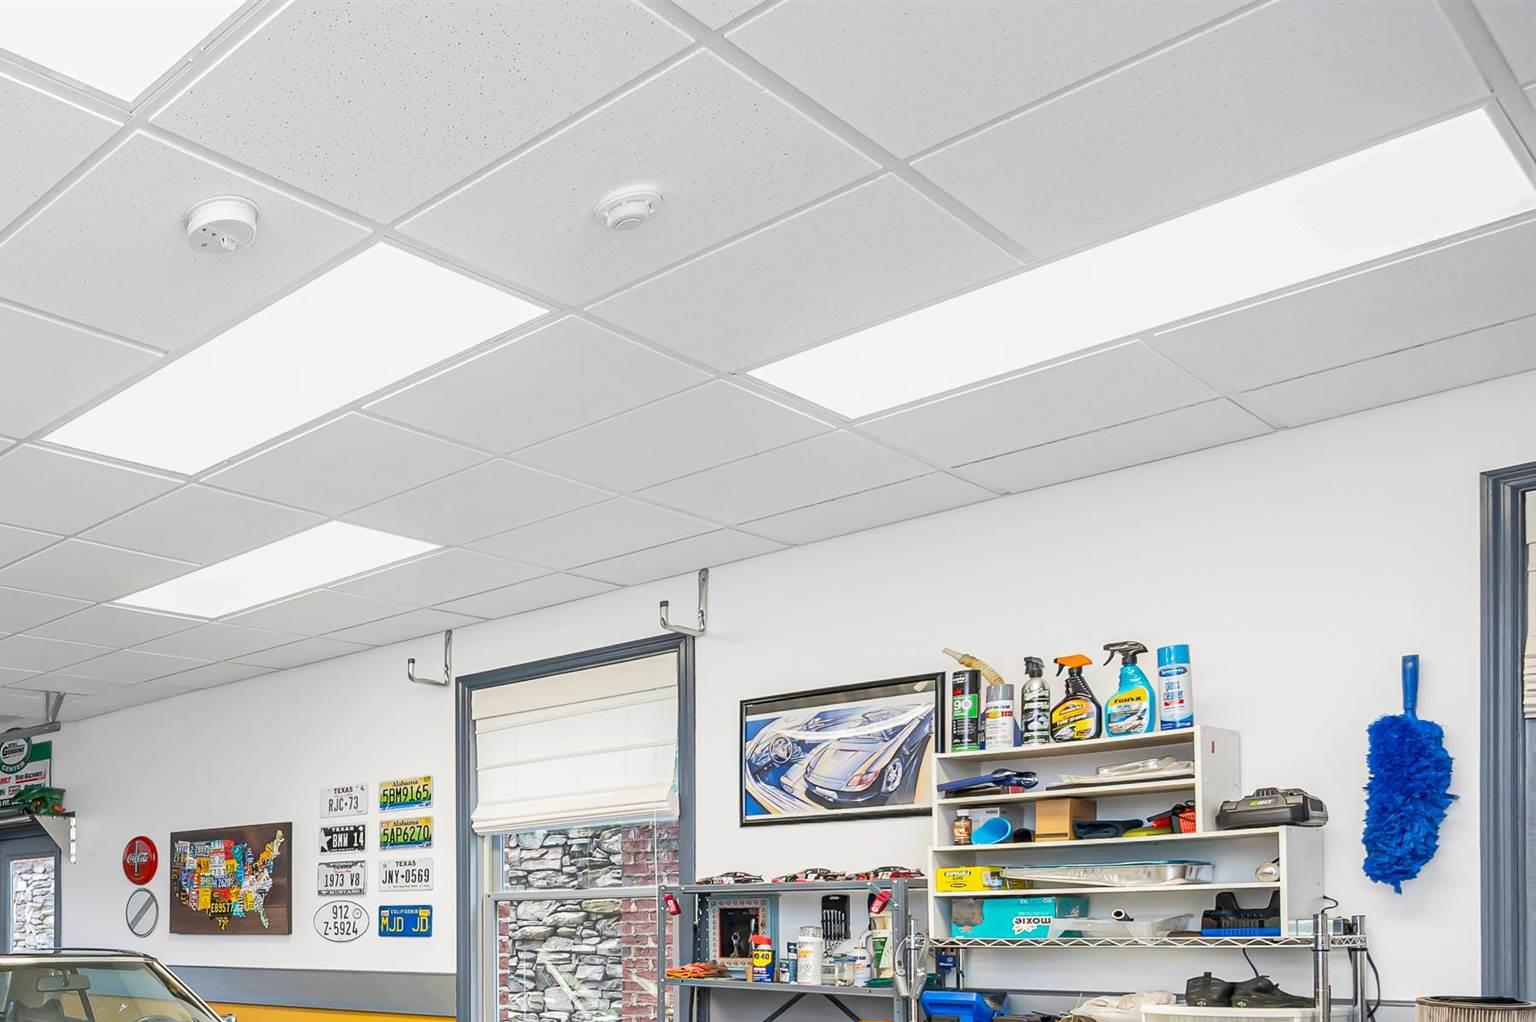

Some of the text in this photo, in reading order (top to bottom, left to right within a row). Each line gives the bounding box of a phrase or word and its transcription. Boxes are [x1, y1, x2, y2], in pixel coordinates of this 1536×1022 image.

[382, 784, 429, 804] 5BM9165
[353, 831, 364, 847] 14
[383, 825, 430, 844] 5AP6270
[324, 872, 360, 887] 1973 V8
[332, 904, 349, 920] 912
[324, 921, 358, 936] Z-5924
[381, 916, 429, 933] MJD JD
